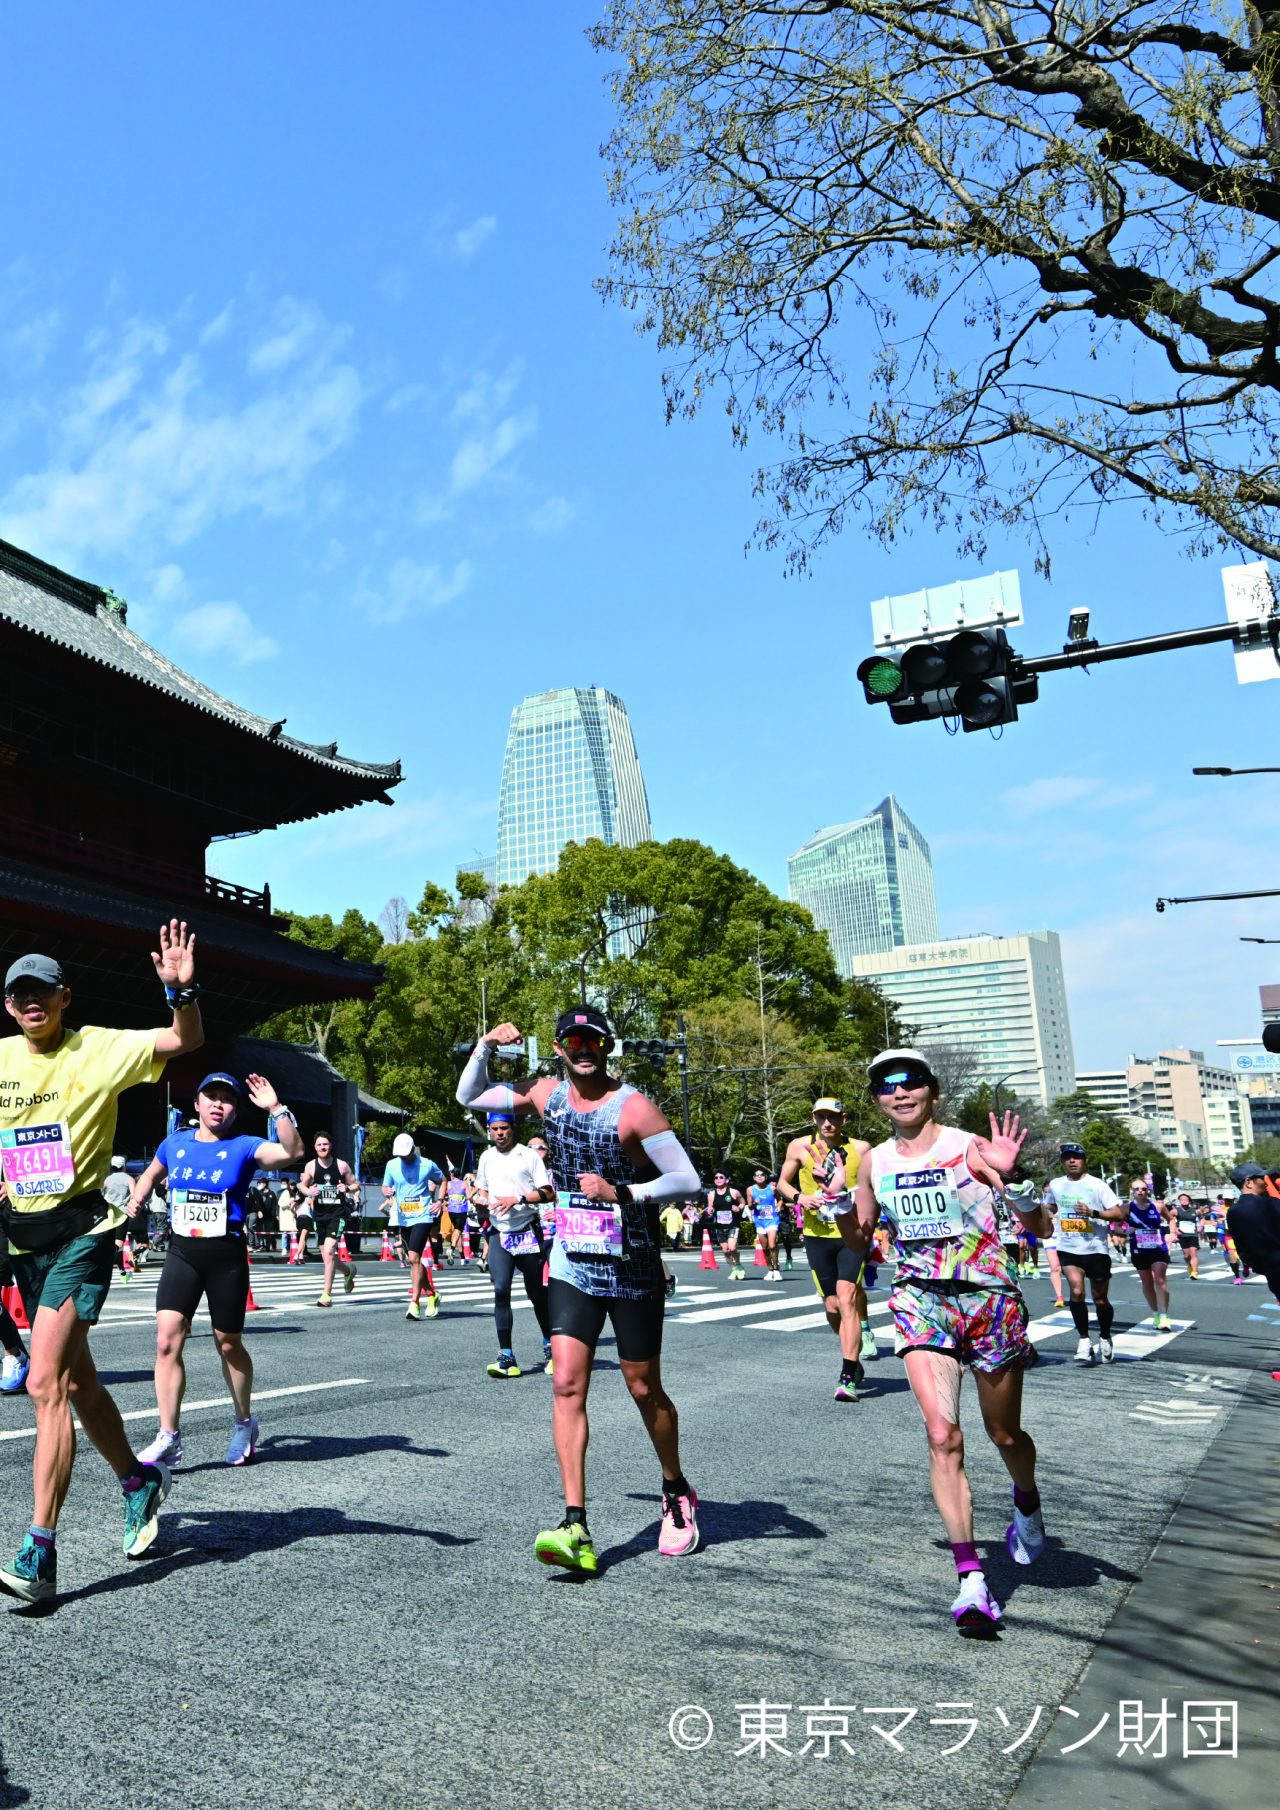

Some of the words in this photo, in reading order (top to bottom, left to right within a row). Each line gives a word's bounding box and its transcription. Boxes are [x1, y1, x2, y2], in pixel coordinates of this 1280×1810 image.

[17, 1127, 59, 1142] 東京メトロ
[13, 1145, 59, 1175] 26491
[24, 1178, 65, 1195] STARTS
[898, 1173, 944, 1187] 東京メトロ
[188, 1193, 220, 1202] 東京メトロ
[893, 1191, 947, 1216] 10010
[183, 1205, 218, 1222] 15203
[564, 1212, 609, 1235] 20581
[904, 1221, 952, 1239] STARTS
